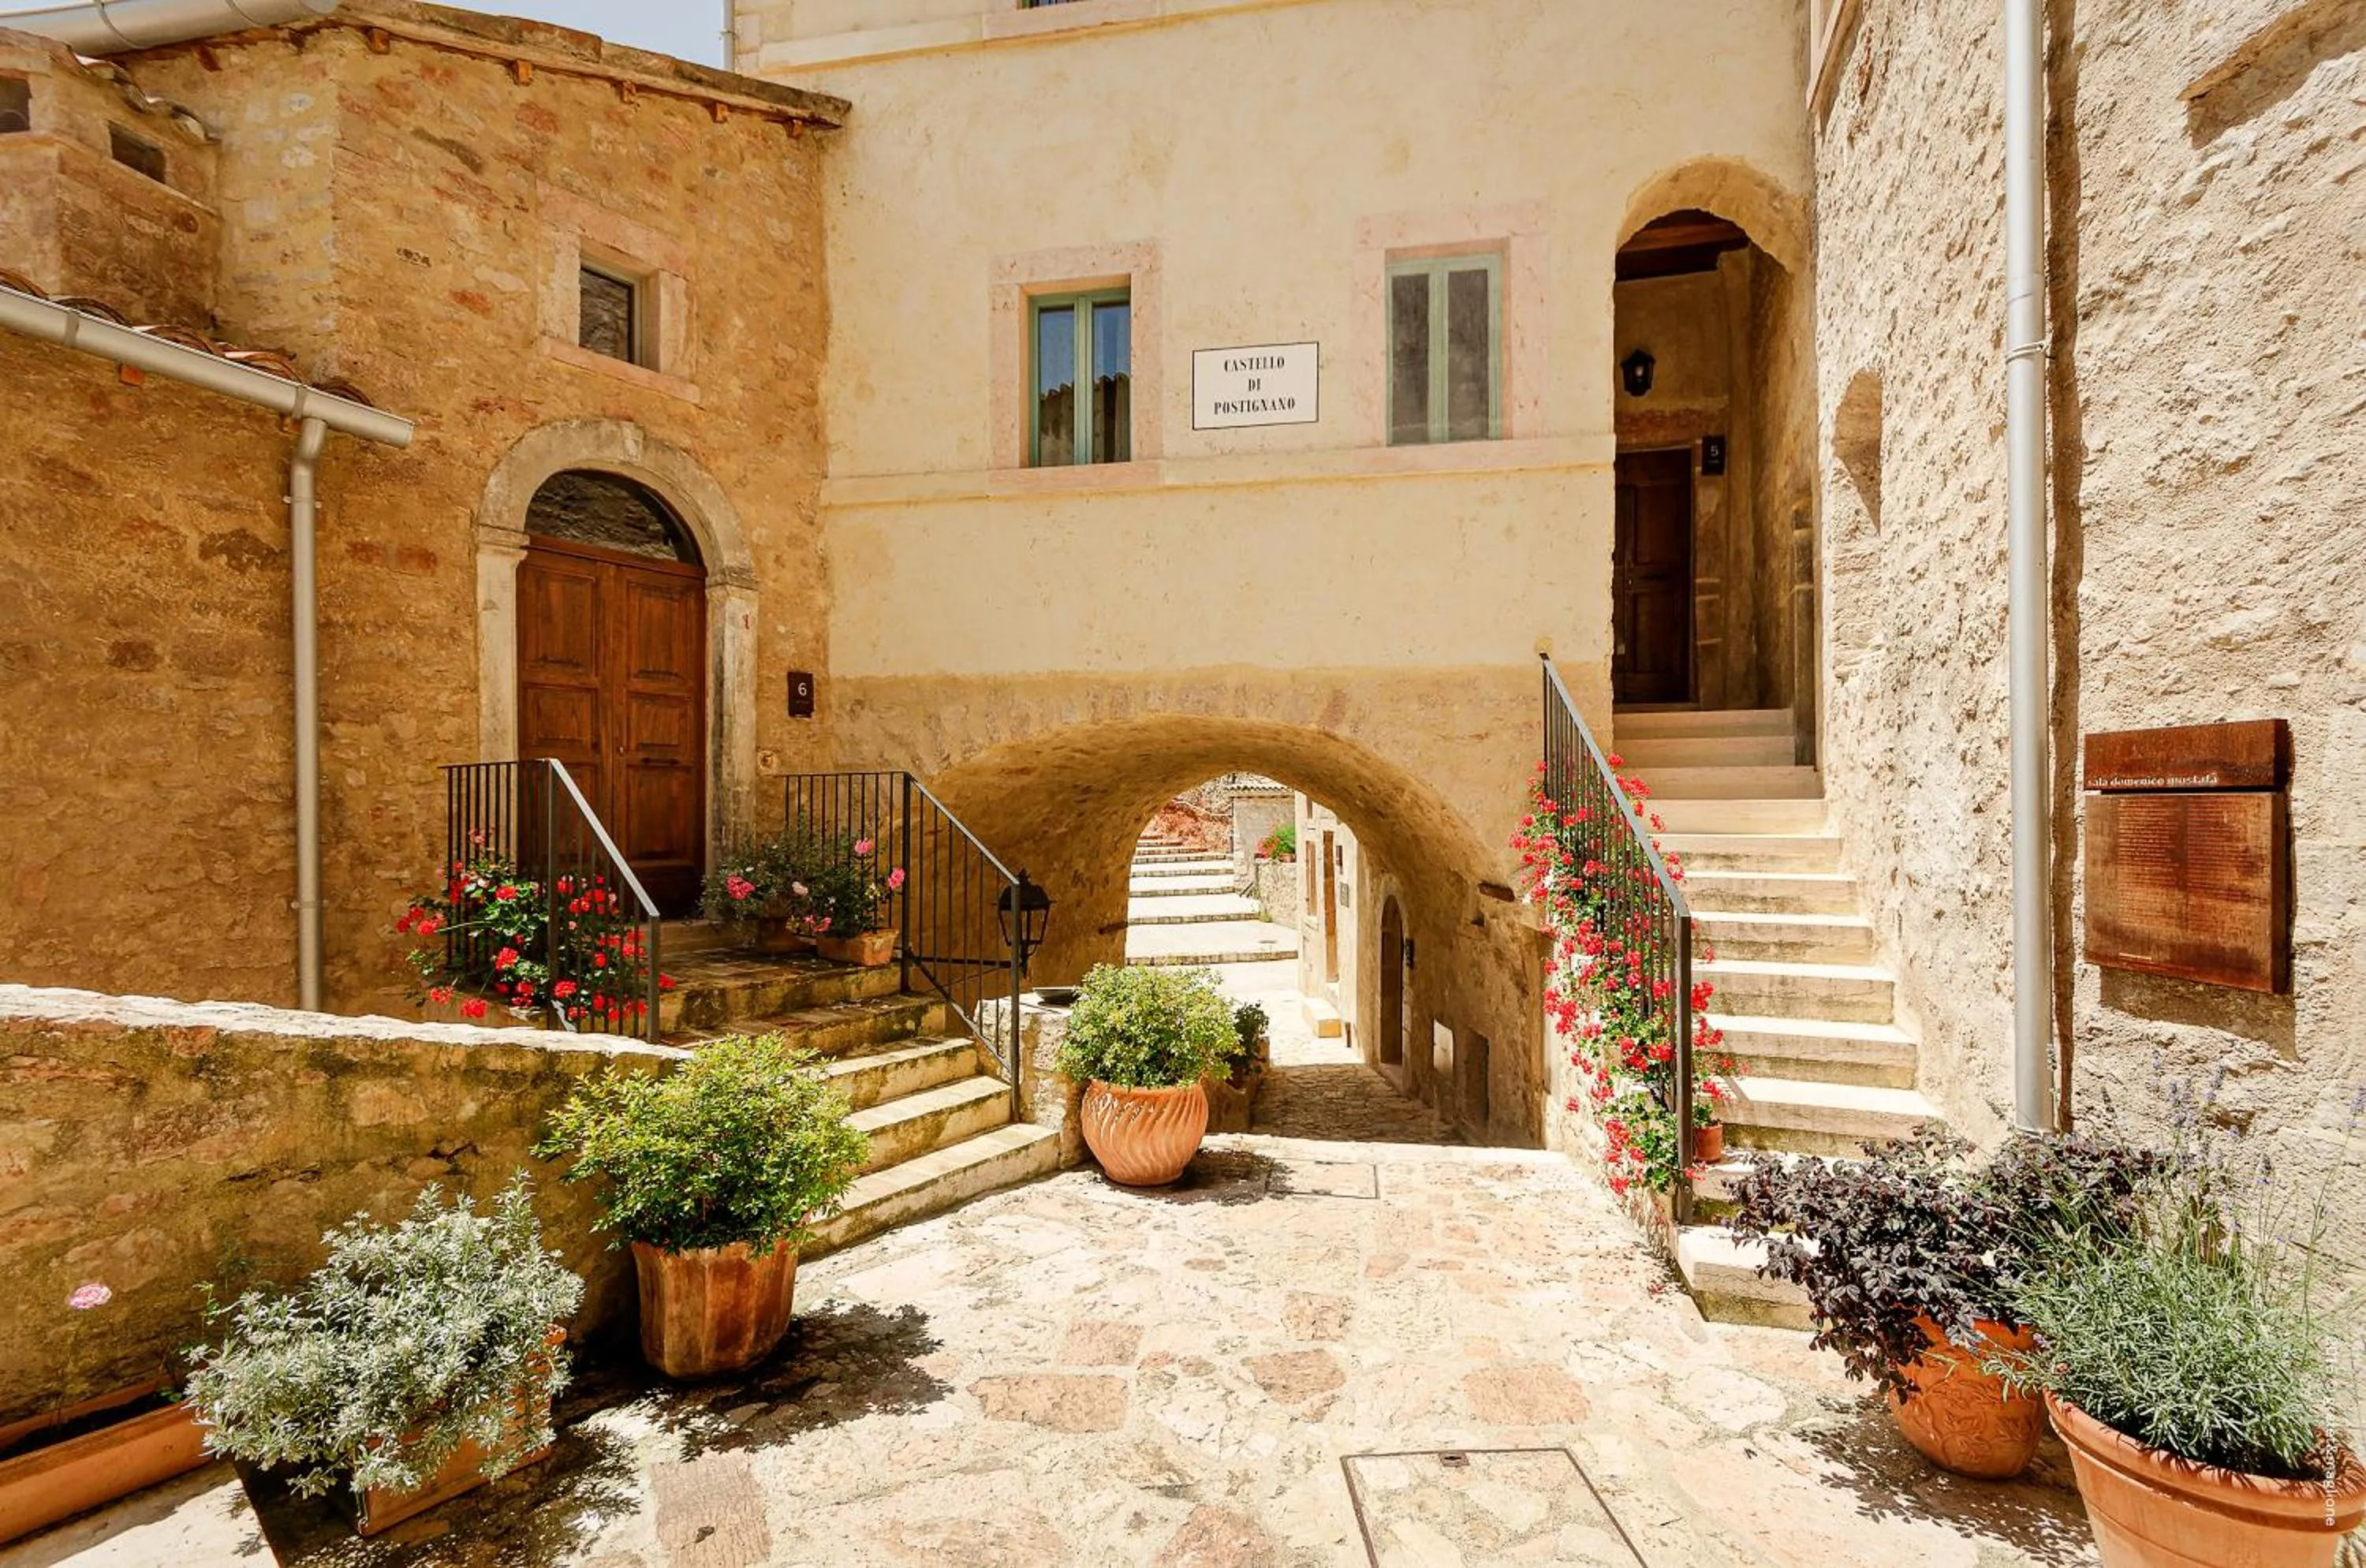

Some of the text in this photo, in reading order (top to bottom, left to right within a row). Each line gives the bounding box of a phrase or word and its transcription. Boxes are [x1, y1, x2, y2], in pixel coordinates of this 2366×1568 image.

[1224, 356, 1285, 372] CASTELLO
[1248, 378, 1261, 391] DI
[1214, 397, 1296, 415] POSTIGNANO
[1711, 445, 1719, 457] 5
[797, 682, 807, 696] 6
